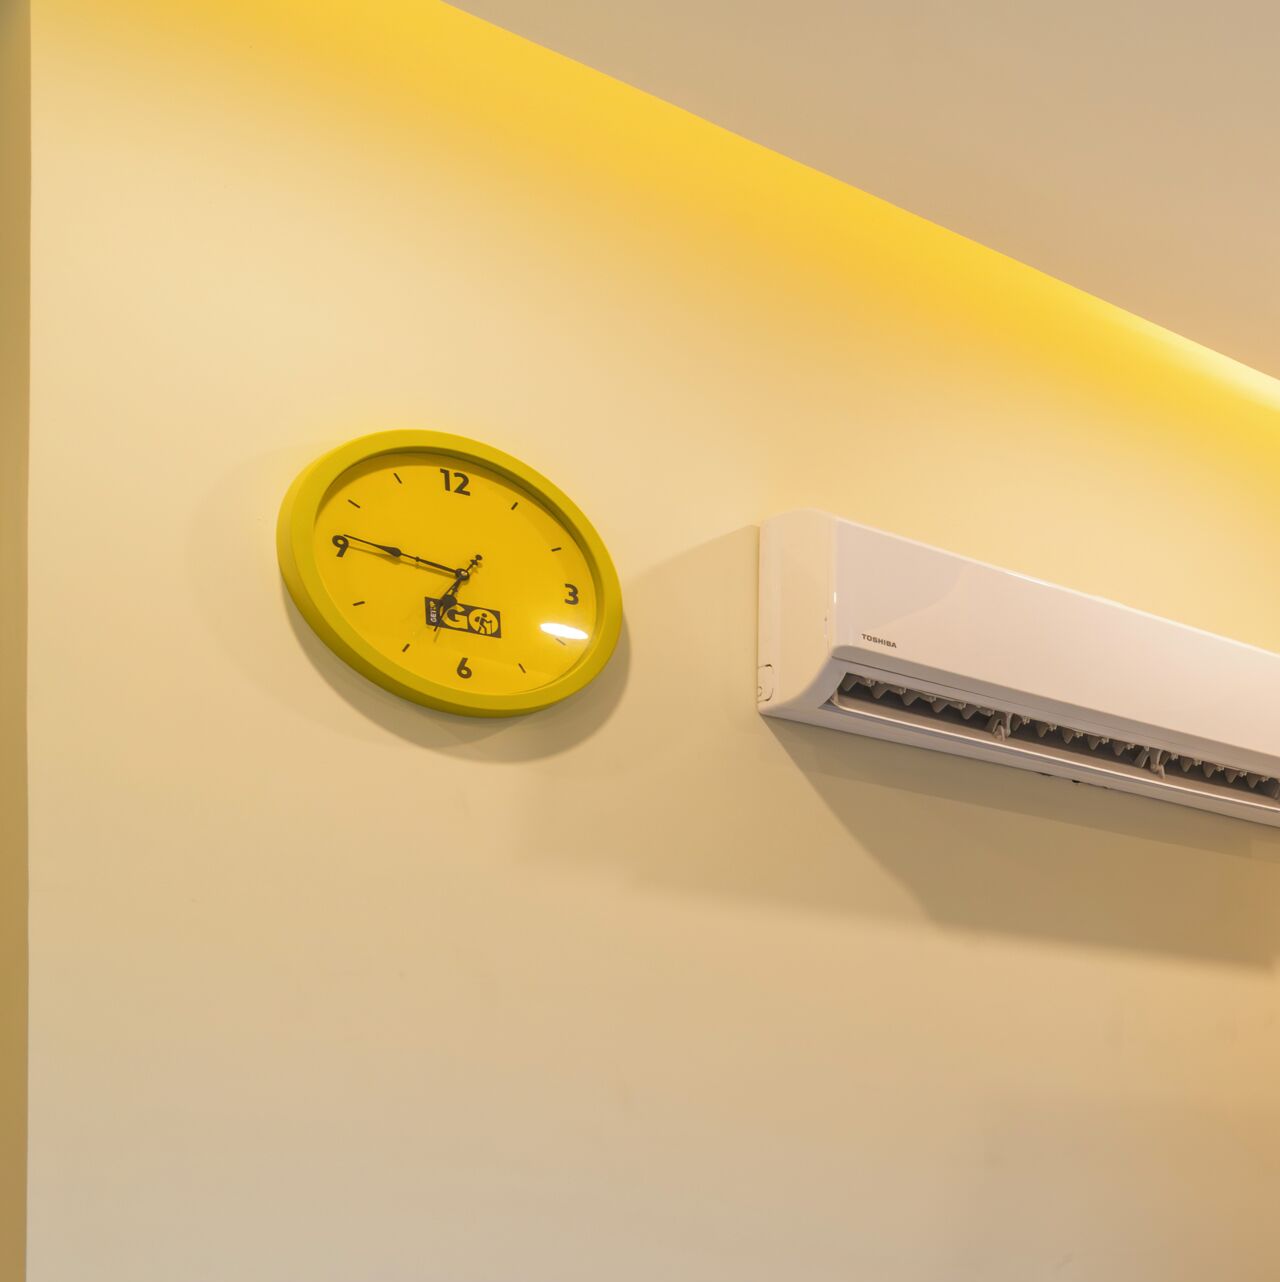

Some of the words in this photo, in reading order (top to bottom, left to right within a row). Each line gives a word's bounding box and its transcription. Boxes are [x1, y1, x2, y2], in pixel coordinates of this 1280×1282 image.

[440, 467, 471, 496] 12
[331, 535, 350, 558] 9
[563, 583, 580, 606] 3
[861, 633, 897, 649] TOSHIBA
[456, 657, 473, 680] 6
